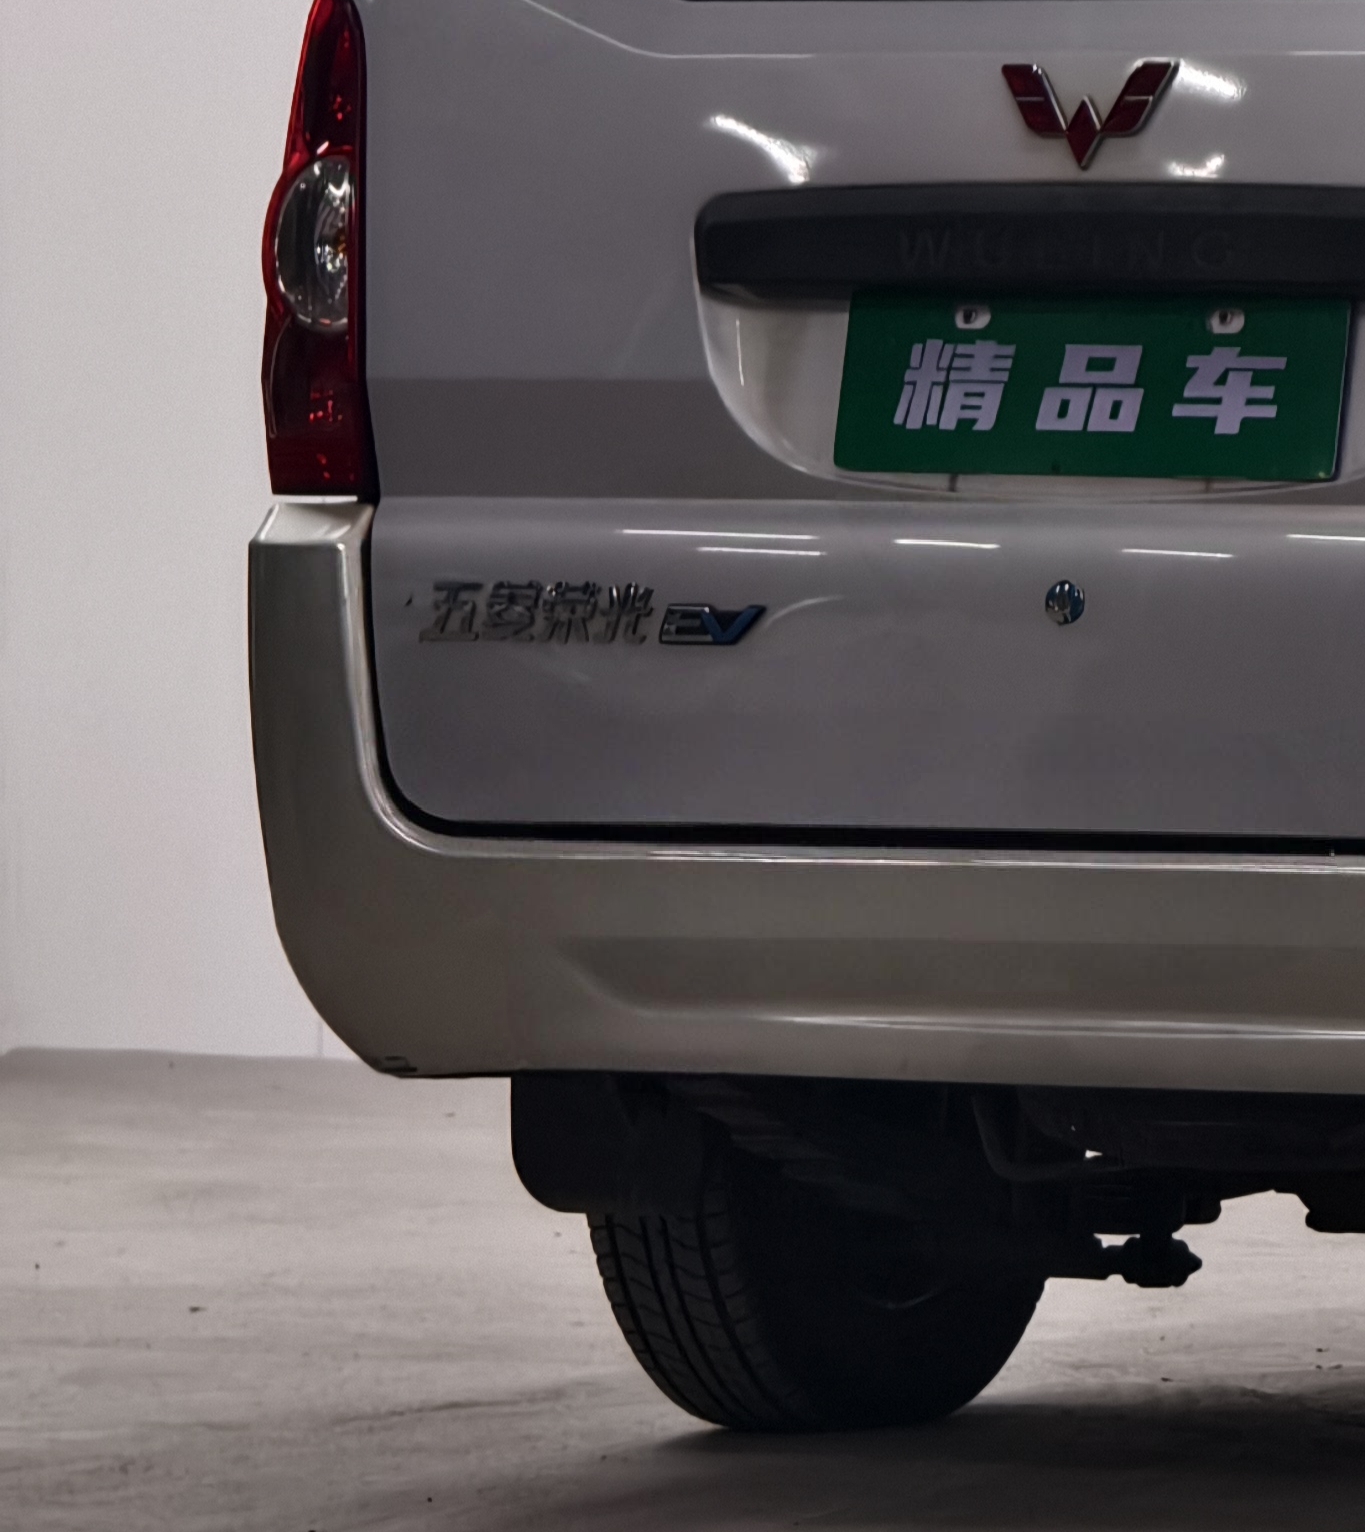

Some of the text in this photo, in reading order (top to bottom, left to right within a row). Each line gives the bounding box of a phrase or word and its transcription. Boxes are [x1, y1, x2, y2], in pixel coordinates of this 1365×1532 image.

[899, 228, 1236, 274] WULING
[893, 339, 1287, 435] 精品车
[419, 580, 767, 646] 五菱荣光 EV
